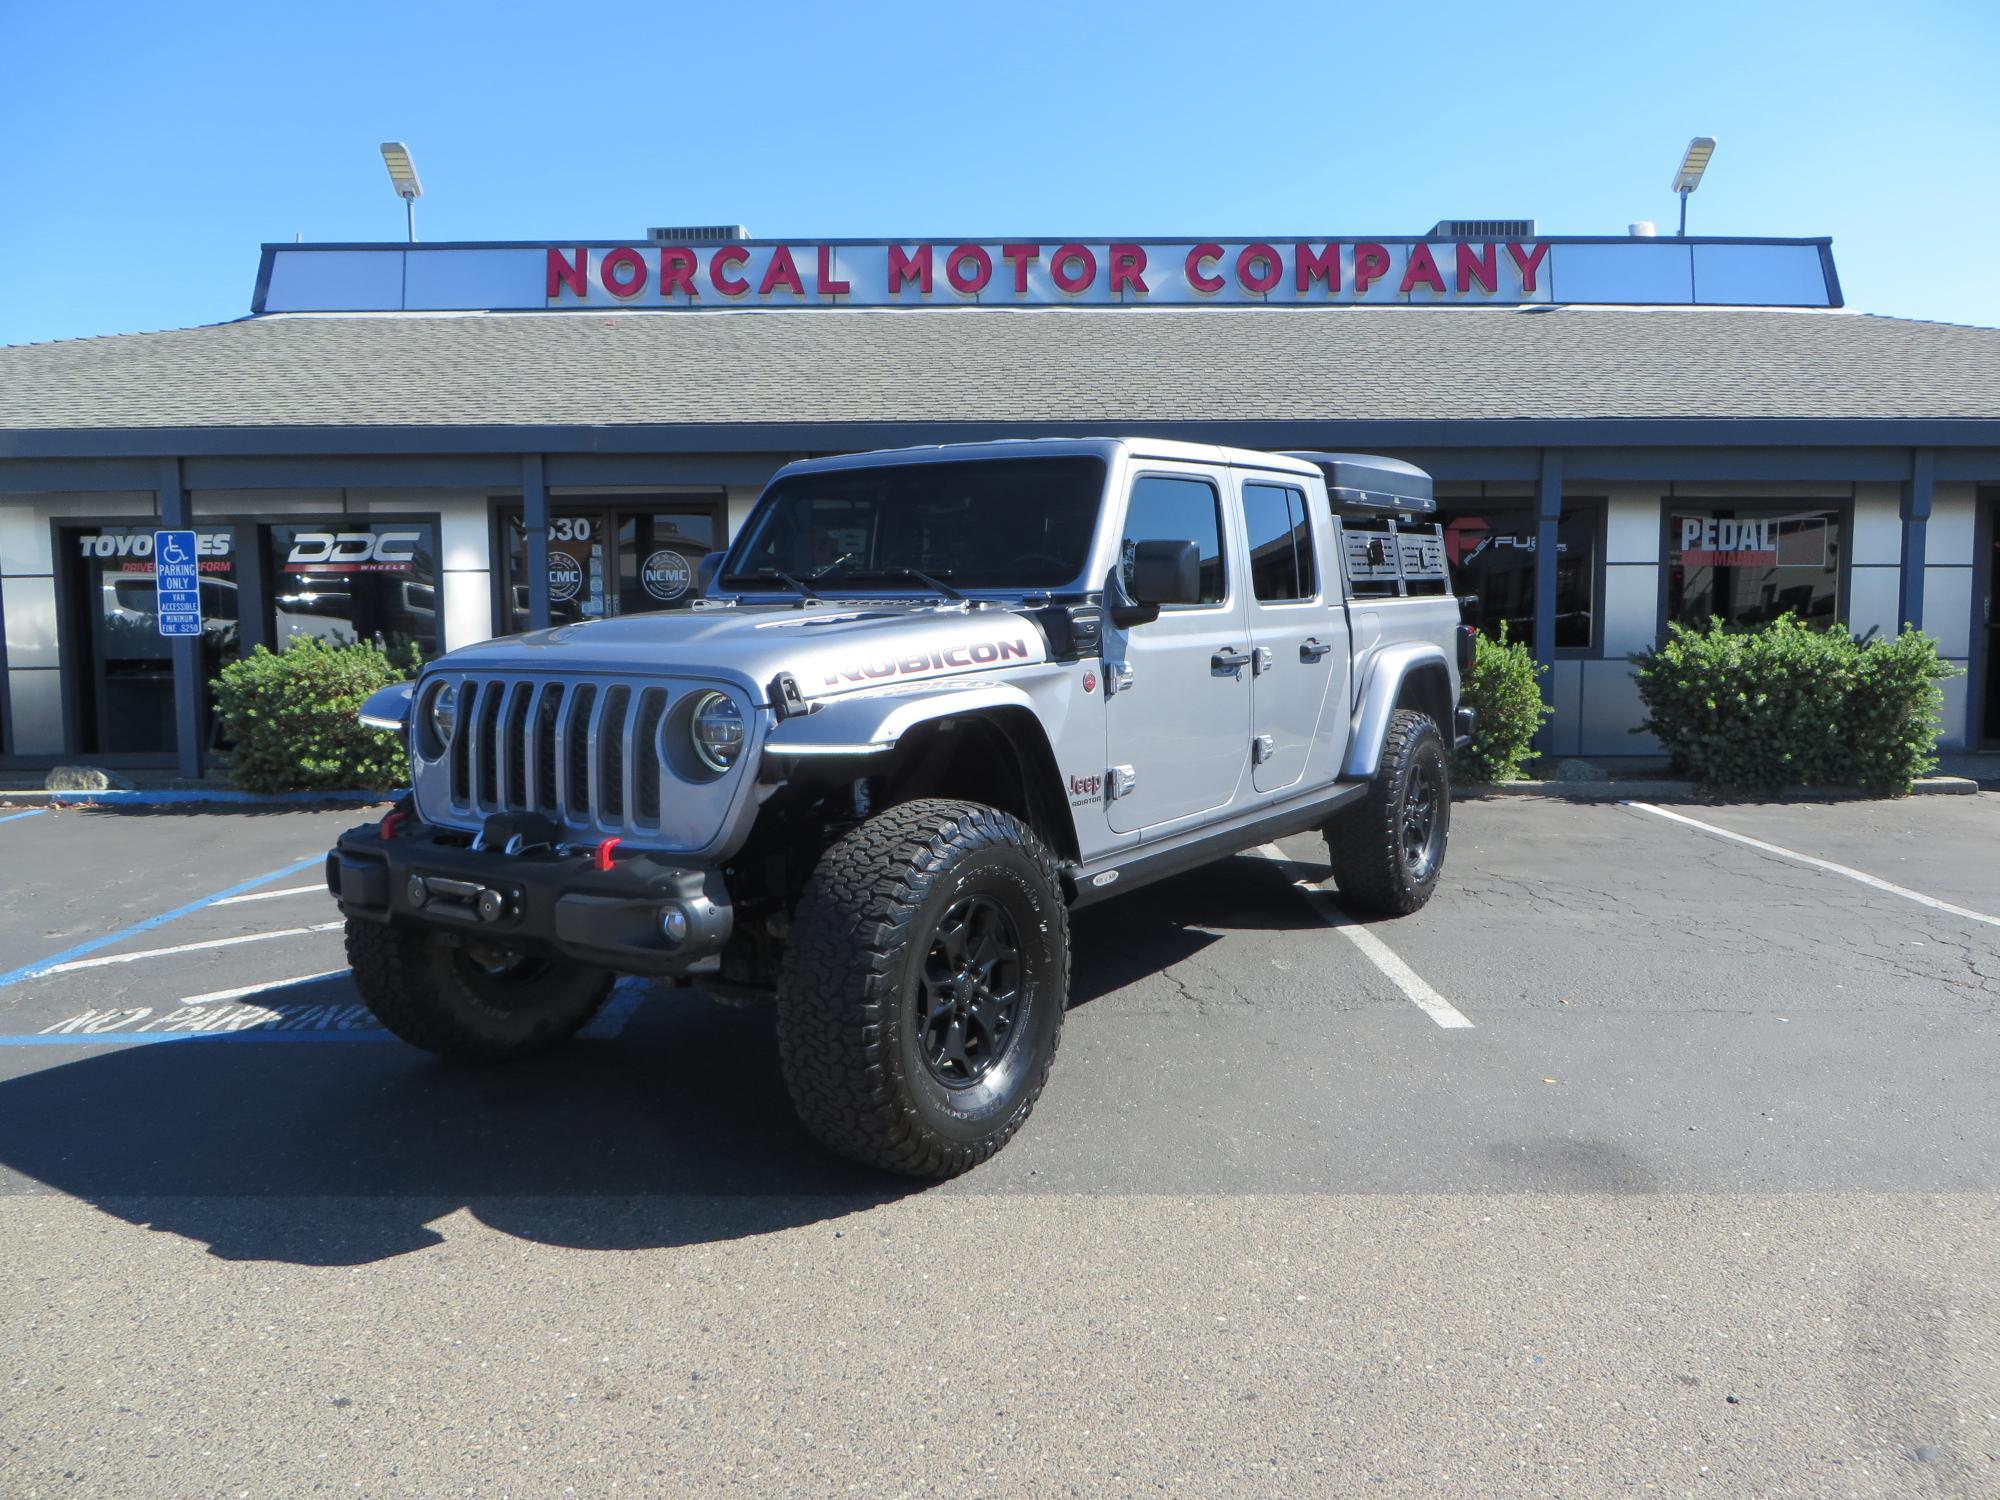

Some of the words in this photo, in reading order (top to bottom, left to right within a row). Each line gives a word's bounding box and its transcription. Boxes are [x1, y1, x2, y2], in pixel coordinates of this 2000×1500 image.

[547, 245, 850, 299] NORCAL
[888, 243, 1148, 297] MOTOR
[1184, 242, 1550, 298] COMPANY
[1681, 518, 1776, 552] PEDAL
[79, 535, 153, 557] TOYO
[287, 532, 420, 562] DDC
[159, 564, 196, 577] PARKING
[548, 570, 579, 582] CMC
[646, 569, 688, 582] NCMC
[166, 577, 189, 590] ONLY
[172, 593, 186, 602] VAN
[161, 602, 197, 611] ACCESSIBLE
[166, 614, 194, 623] MINIMUM
[161, 624, 177, 633] FINE
[180, 624, 199, 633] $250
[824, 638, 1028, 685] RUBICON
[1068, 774, 1102, 796] Jeep
